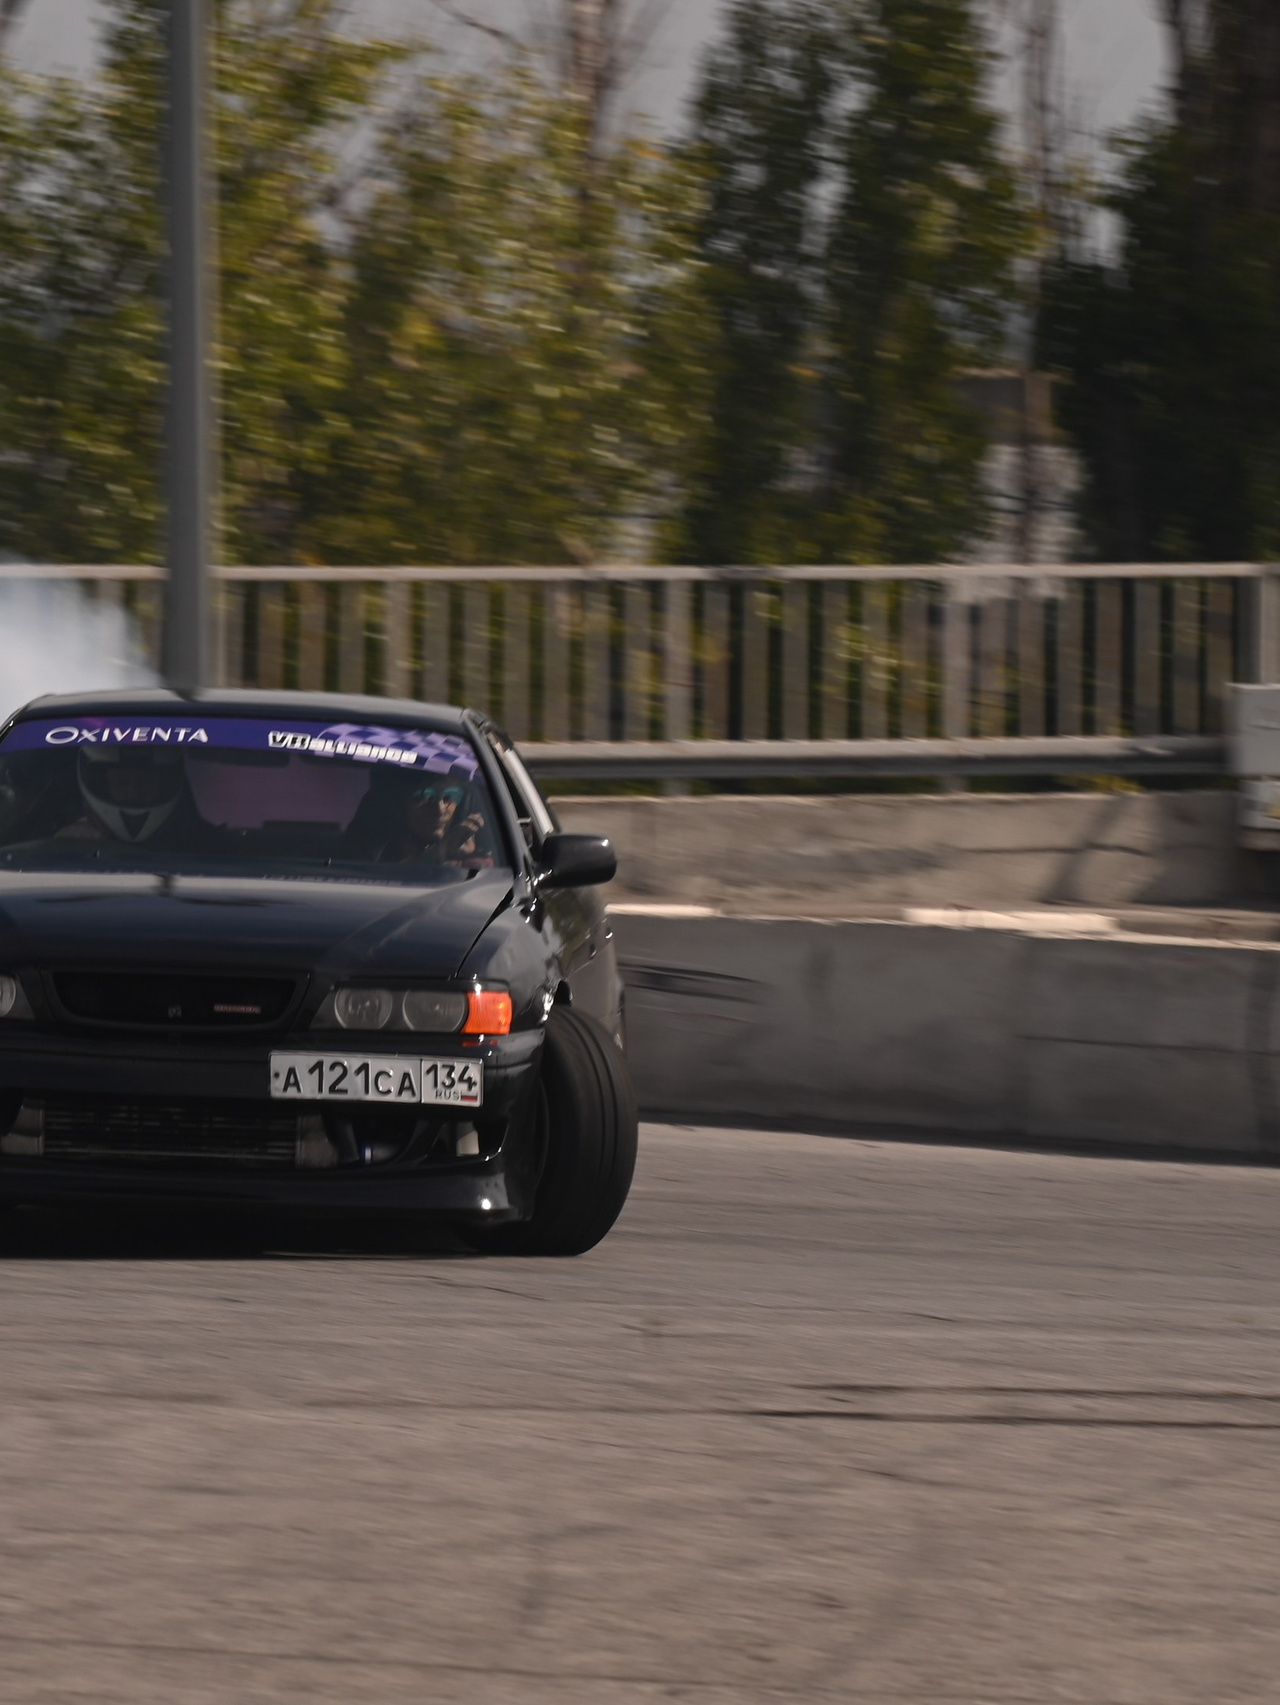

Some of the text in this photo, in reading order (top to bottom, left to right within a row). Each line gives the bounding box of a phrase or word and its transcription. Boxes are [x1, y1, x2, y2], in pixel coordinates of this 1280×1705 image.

[45, 726, 209, 744] OXIVENTA
[426, 1063, 478, 1092] 134
[435, 1090, 461, 1100] RUS
